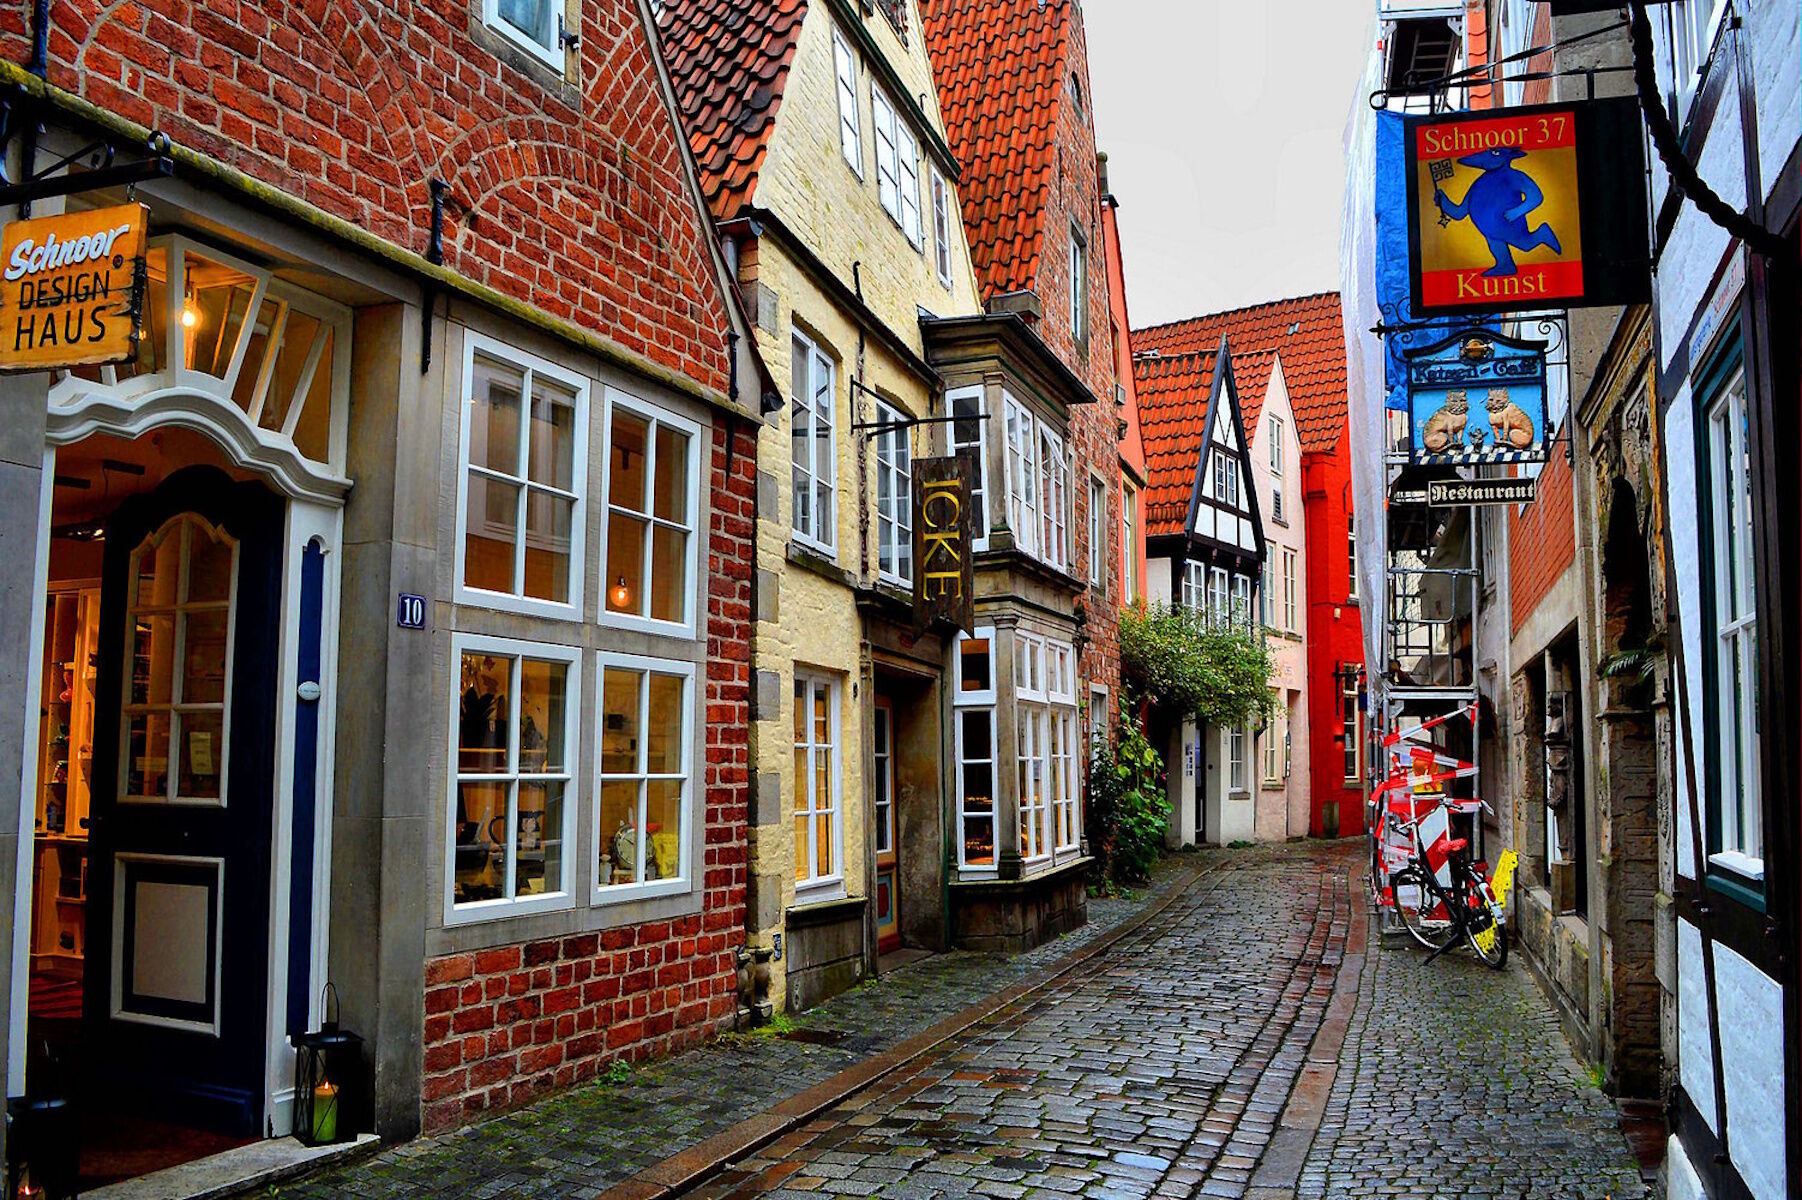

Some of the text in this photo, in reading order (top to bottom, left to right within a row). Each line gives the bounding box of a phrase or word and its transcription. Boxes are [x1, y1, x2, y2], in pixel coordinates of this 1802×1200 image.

[1425, 117, 1566, 153] Schnoor 37
[4, 224, 130, 280] Schnoor
[19, 270, 110, 310] DESIGN
[1456, 271, 1548, 298] Kunst
[14, 306, 107, 351] HAUS
[1431, 484, 1534, 502] Restaurant
[923, 477, 961, 601] ICKE
[403, 598, 423, 625] 10
